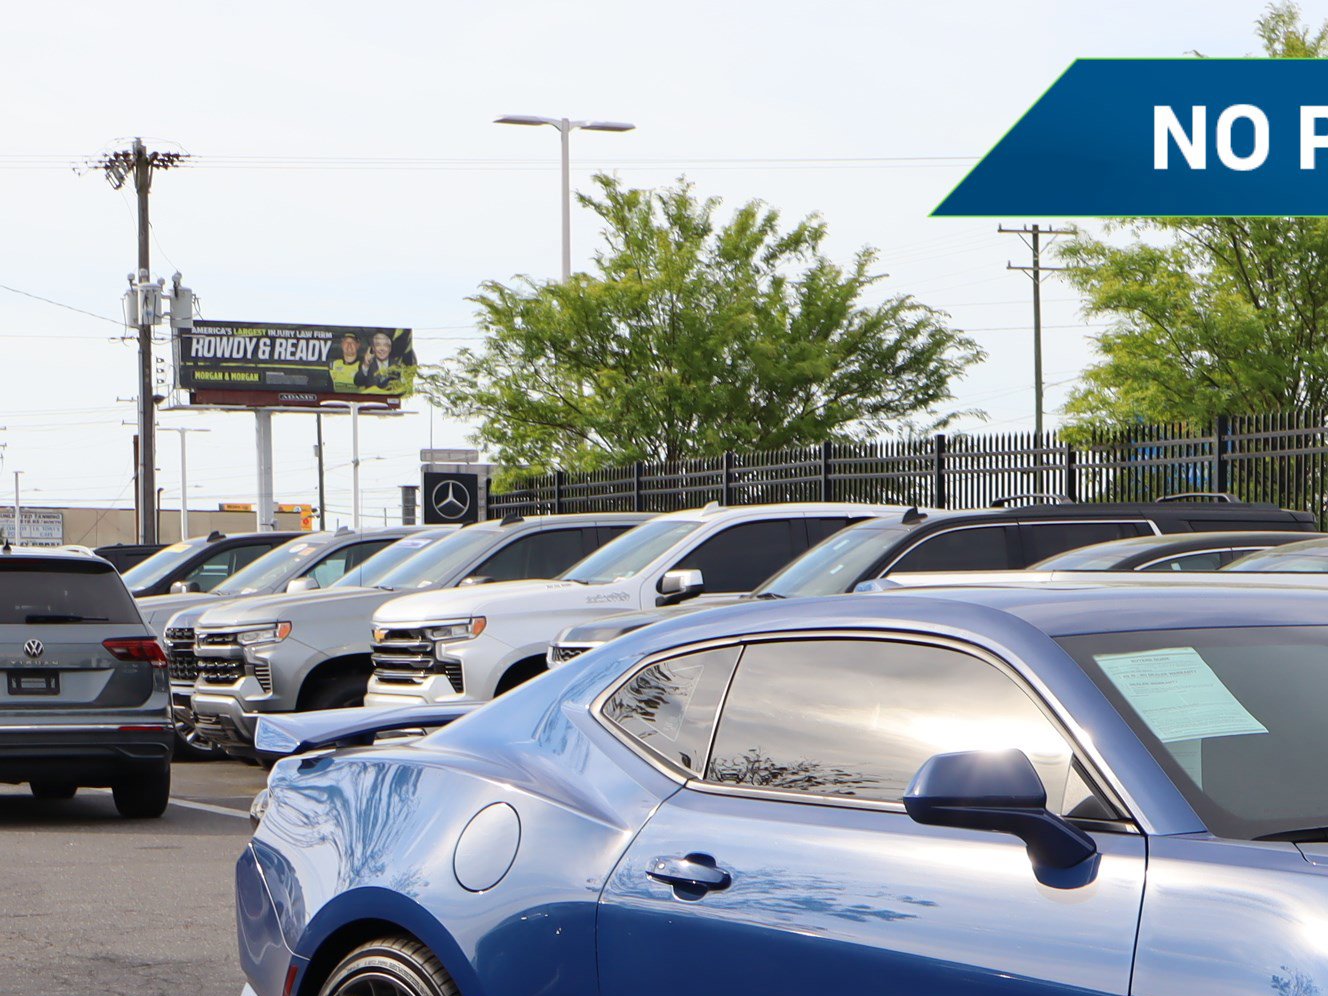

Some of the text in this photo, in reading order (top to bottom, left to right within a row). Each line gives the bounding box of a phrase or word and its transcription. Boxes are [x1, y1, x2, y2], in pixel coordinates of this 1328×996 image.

[191, 326, 232, 335] AMERICA'S
[233, 328, 266, 336] LARGEST
[267, 329, 295, 338] INJURY
[314, 331, 333, 339] FIRM
[258, 338, 271, 360] &
[274, 338, 332, 362] READY
[194, 371, 259, 382] MORGAN & MORGAN
